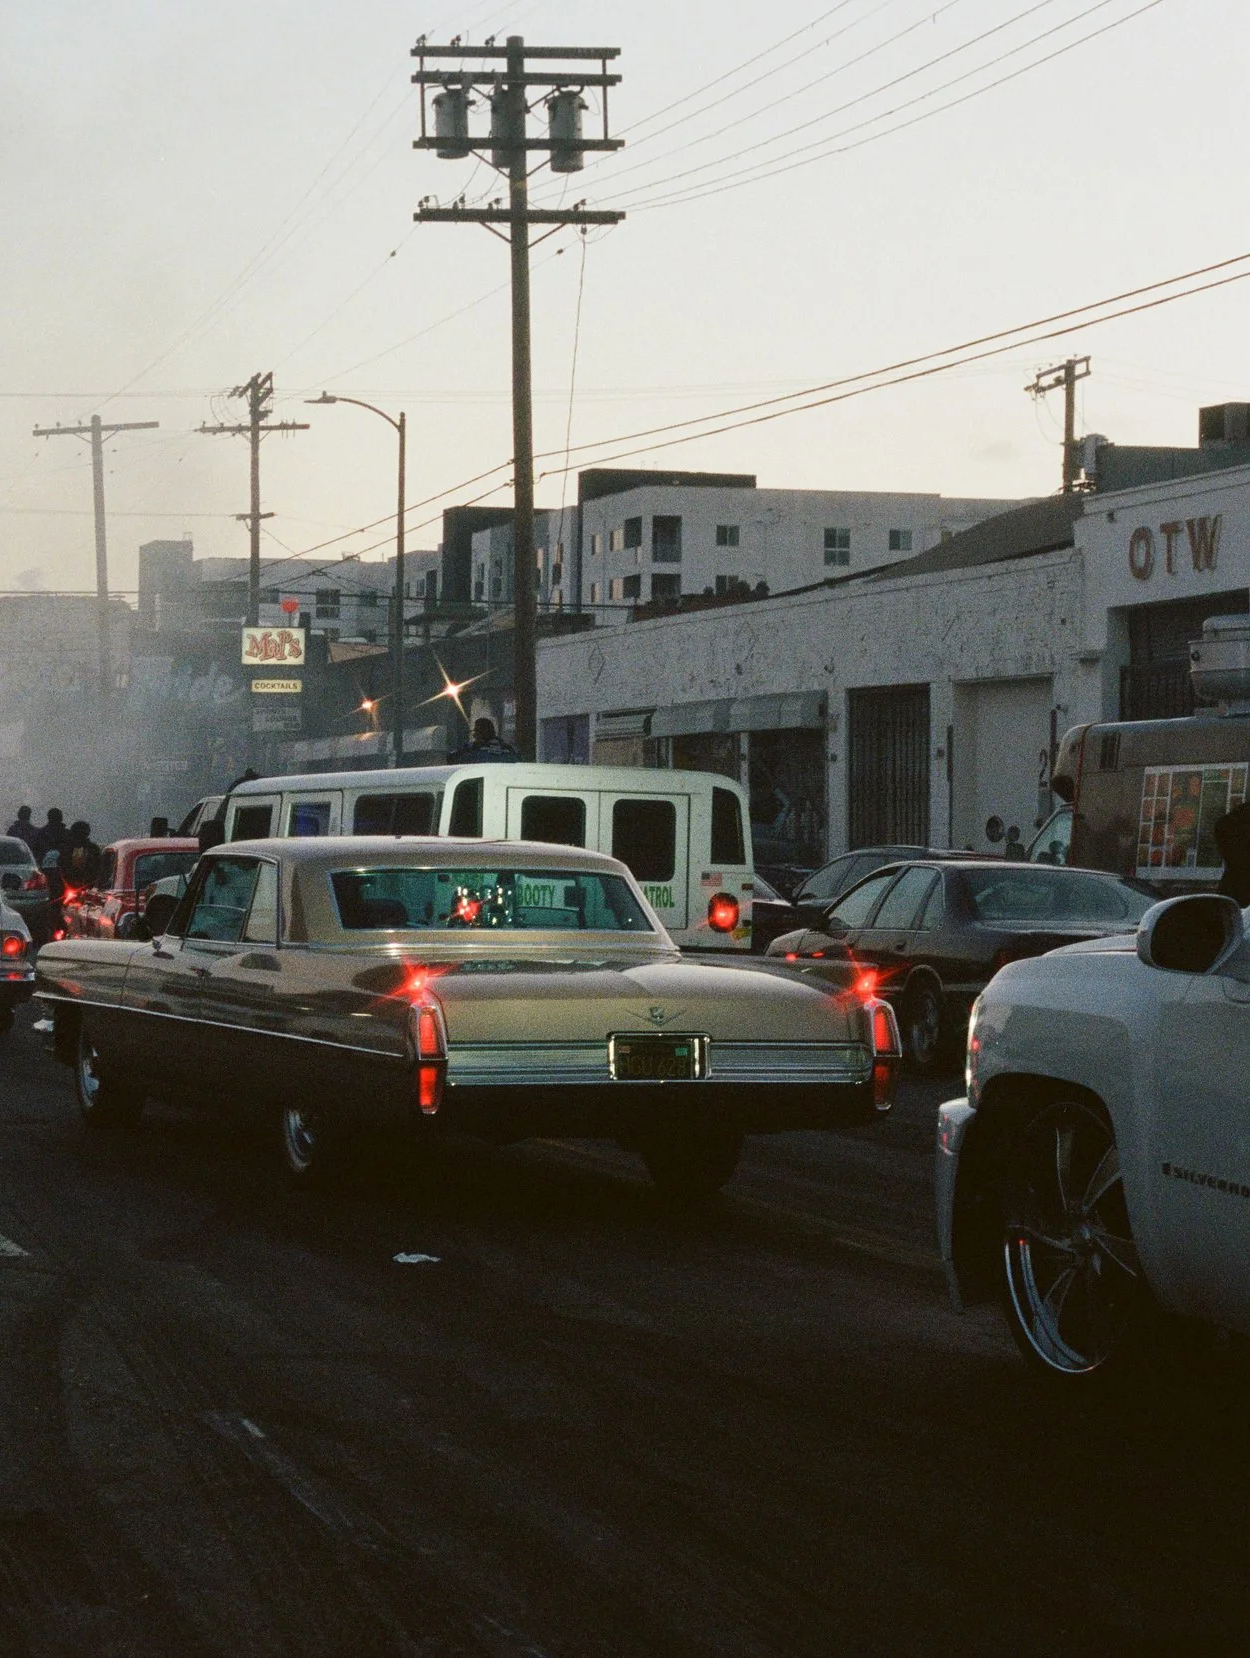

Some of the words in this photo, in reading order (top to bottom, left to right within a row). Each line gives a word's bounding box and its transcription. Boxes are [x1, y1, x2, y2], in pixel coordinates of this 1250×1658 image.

[1129, 514, 1222, 580] OTW
[254, 682, 298, 690] COCKTAILS
[517, 884, 555, 906] BOOTY
